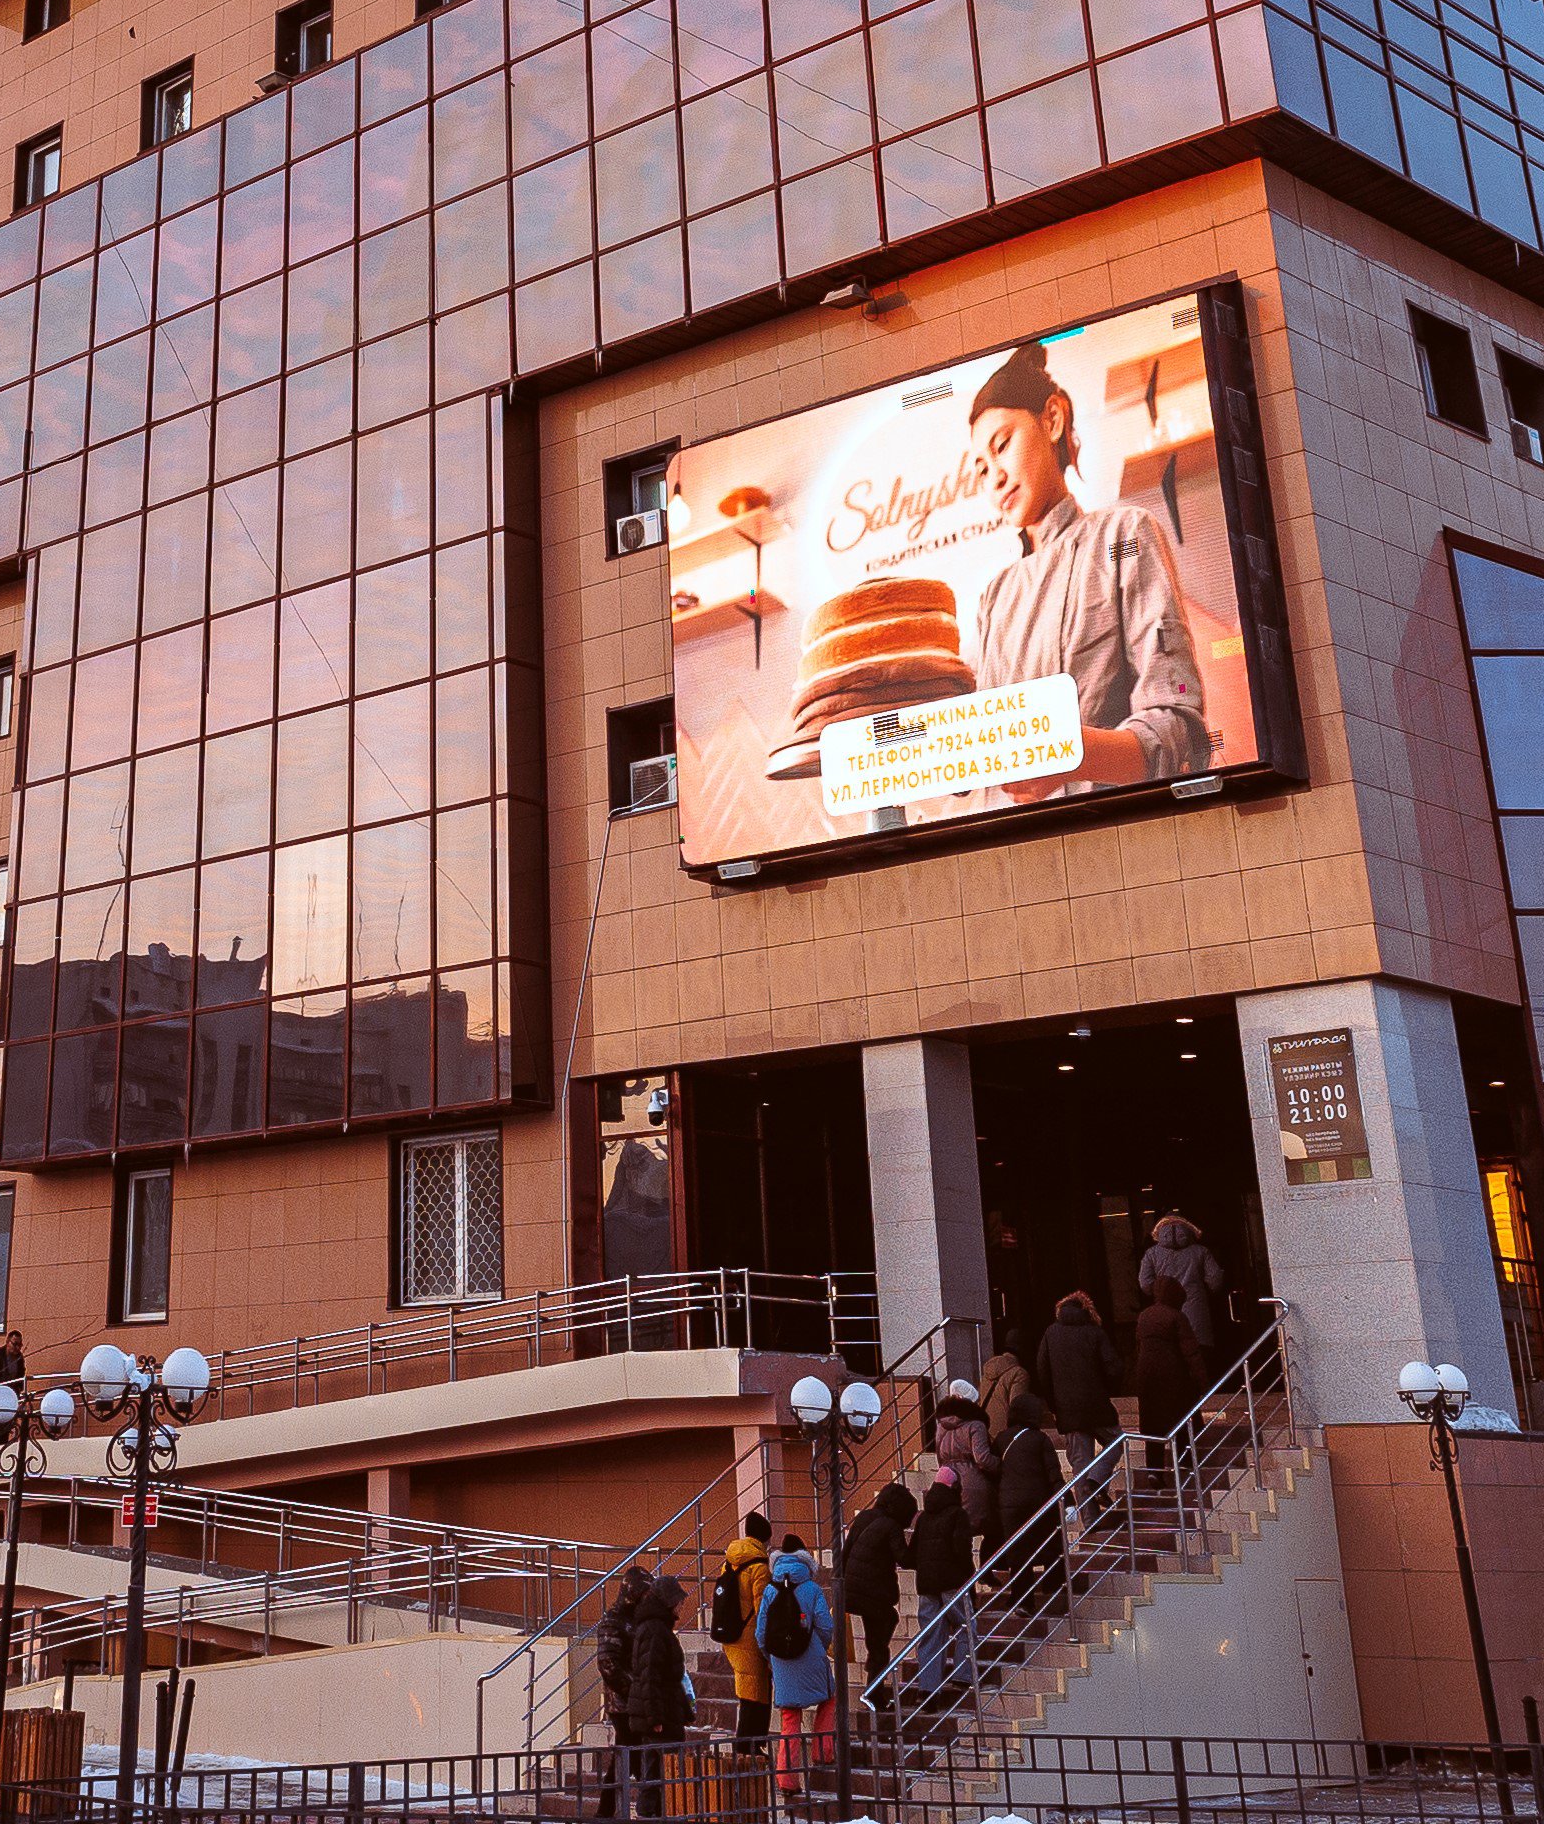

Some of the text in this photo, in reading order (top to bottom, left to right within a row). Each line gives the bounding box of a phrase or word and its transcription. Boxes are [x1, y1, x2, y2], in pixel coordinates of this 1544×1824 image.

[848, 715, 1051, 772] ТЕЛЕФОН +7924 461 40 90
[831, 739, 1076, 804] УЛ. ЛЕРМОНТОВА 36, 2 ЭТАЖ
[1281, 1060, 1343, 1074] РЕЖИМ РАБОТЫ
[1287, 1084, 1345, 1106] 10:00
[1289, 1103, 1348, 1124] 21:00
